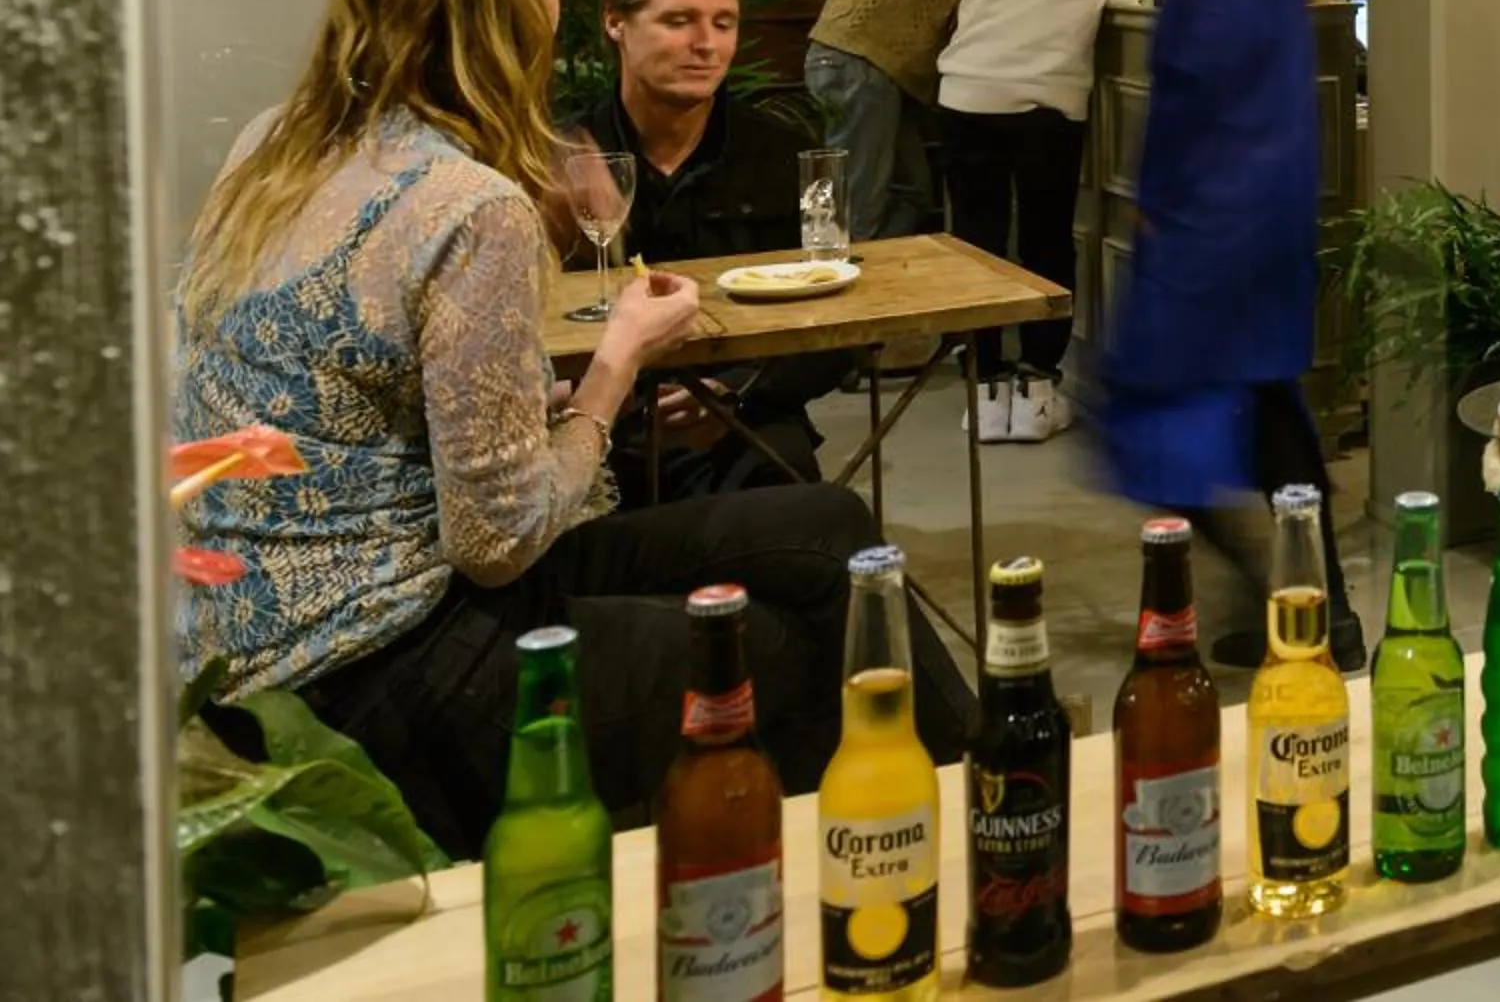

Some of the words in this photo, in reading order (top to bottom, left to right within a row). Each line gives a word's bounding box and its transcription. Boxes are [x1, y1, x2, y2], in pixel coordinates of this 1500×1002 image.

[1298, 759, 1341, 779] Extra
[970, 804, 1063, 839] GUINNESS
[826, 822, 926, 864] Corona
[850, 858, 909, 880] Extra
